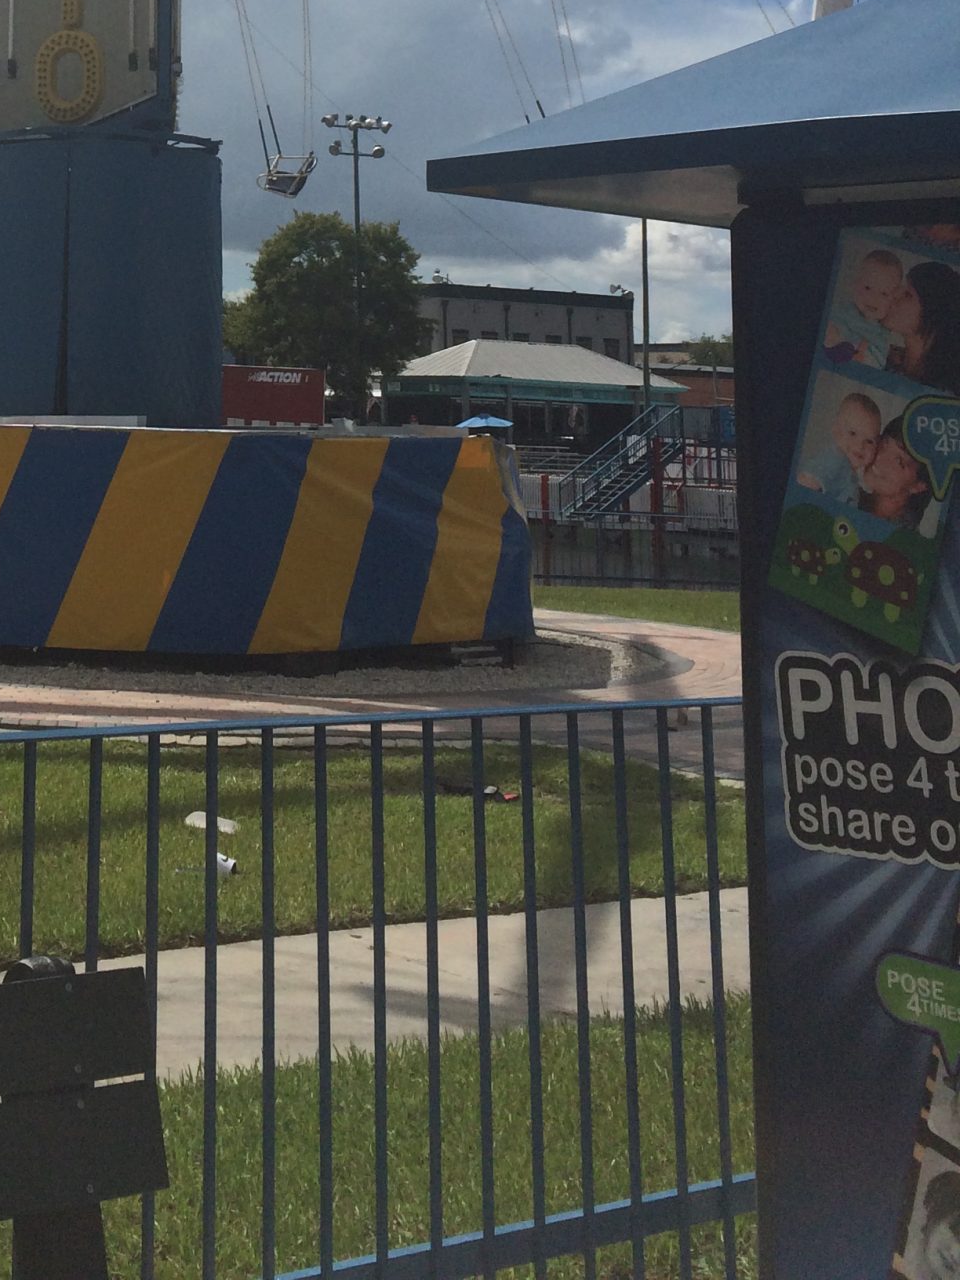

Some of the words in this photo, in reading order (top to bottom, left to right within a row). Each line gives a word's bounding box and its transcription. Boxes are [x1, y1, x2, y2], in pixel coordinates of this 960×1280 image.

[788, 668, 960, 754] PHO
[794, 754, 894, 793] pose
[906, 756, 933, 798] 4
[798, 794, 916, 846] share
[887, 969, 945, 1001] POSE
